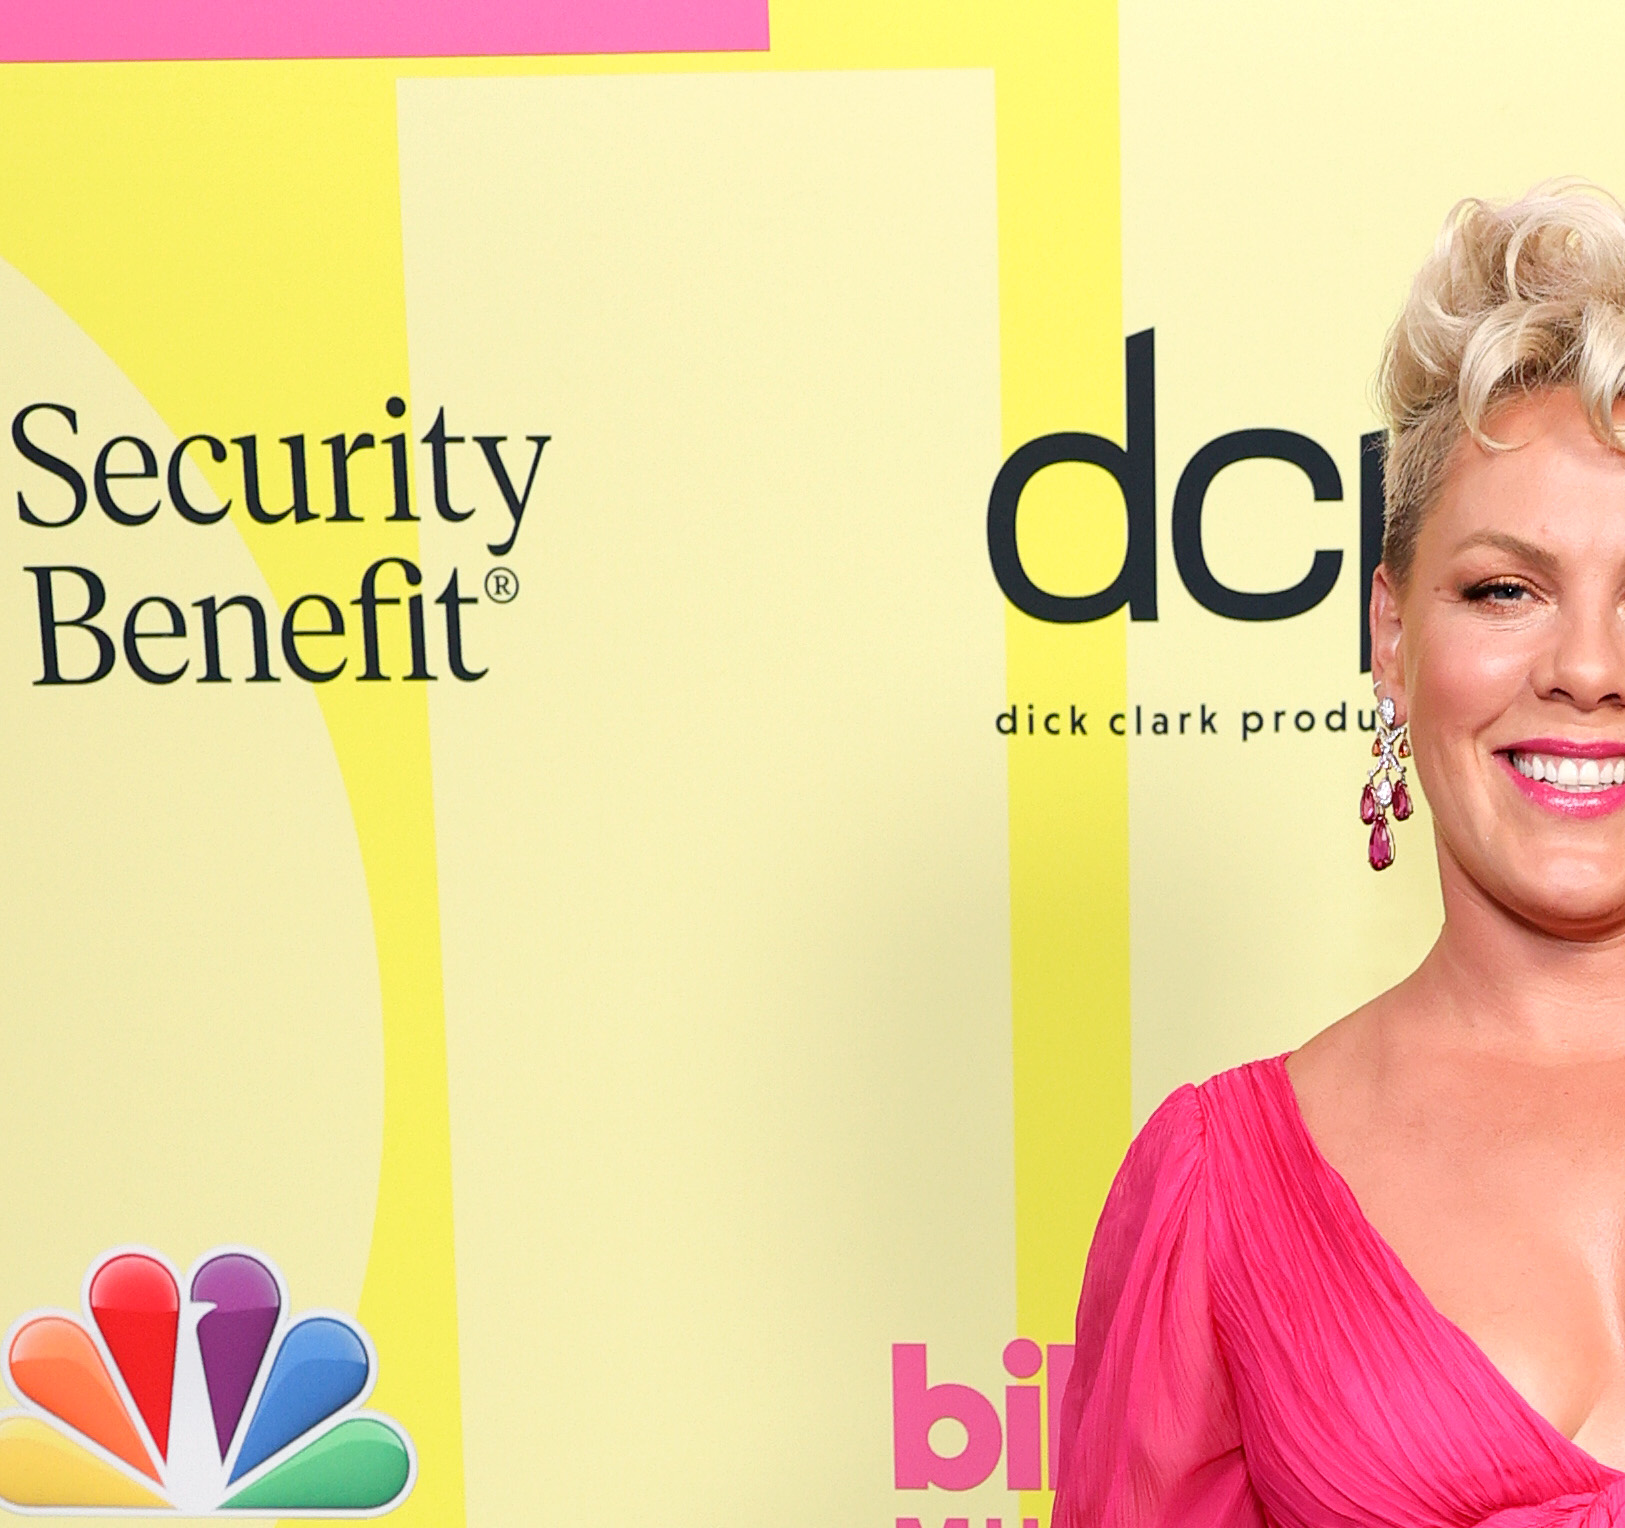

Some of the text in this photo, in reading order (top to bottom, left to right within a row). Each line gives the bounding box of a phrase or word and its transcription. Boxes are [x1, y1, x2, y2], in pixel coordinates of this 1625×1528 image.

[11, 396, 552, 556] Security
[986, 327, 1386, 674] dc
[995, 704, 1088, 736] dick
[1109, 703, 1218, 736] clark
